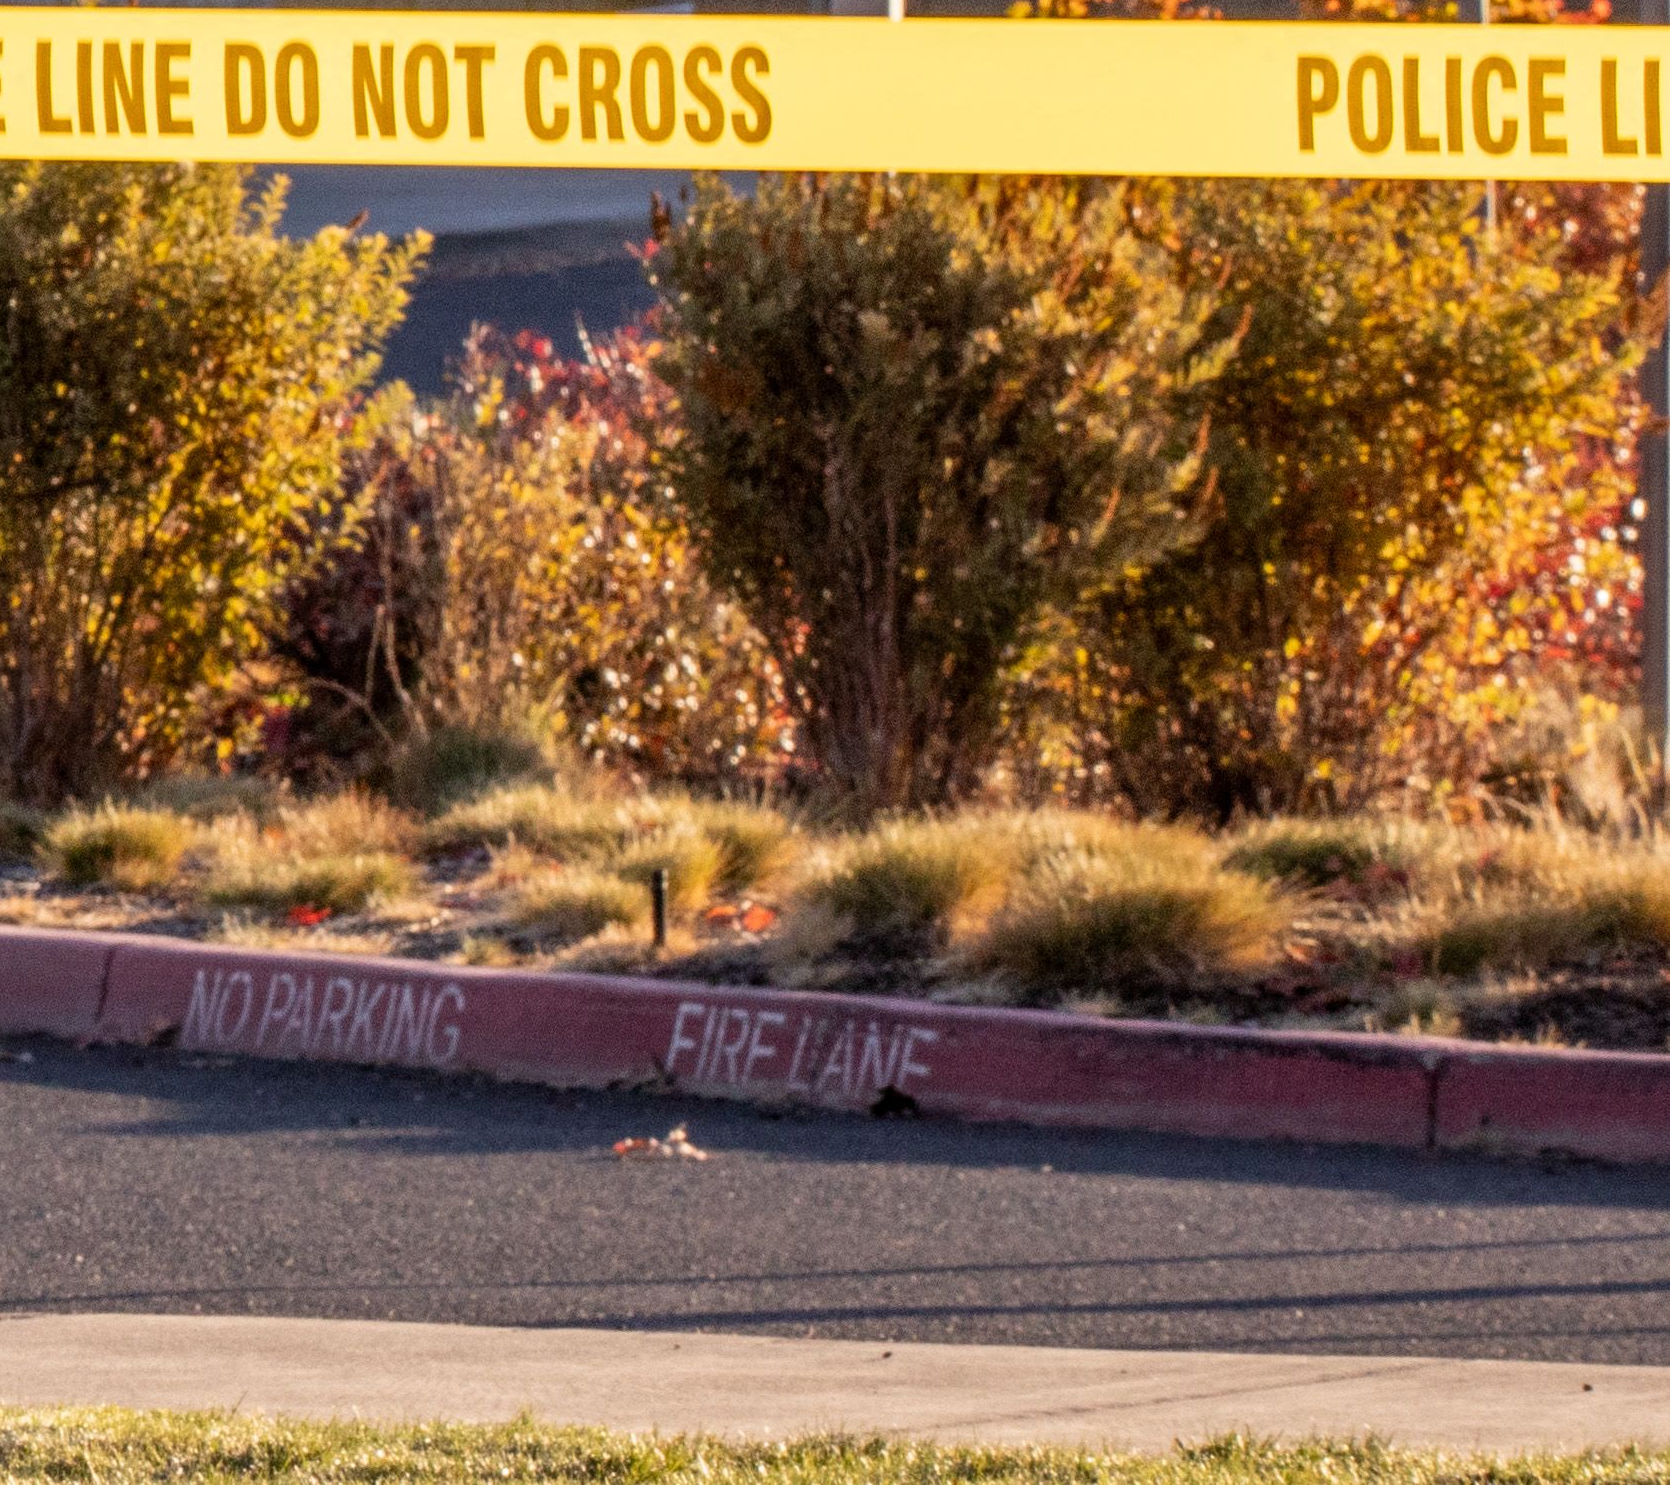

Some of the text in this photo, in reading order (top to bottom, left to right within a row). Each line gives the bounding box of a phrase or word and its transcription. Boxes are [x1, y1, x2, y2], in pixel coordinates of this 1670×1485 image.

[36, 42, 193, 134] LINE
[225, 43, 319, 137] DO
[353, 44, 495, 139] NOT
[525, 45, 771, 143] CROSS
[1298, 56, 1567, 155] POLICE
[186, 968, 465, 1064] NO PARKING
[666, 1000, 938, 1096] FIRE LANE
